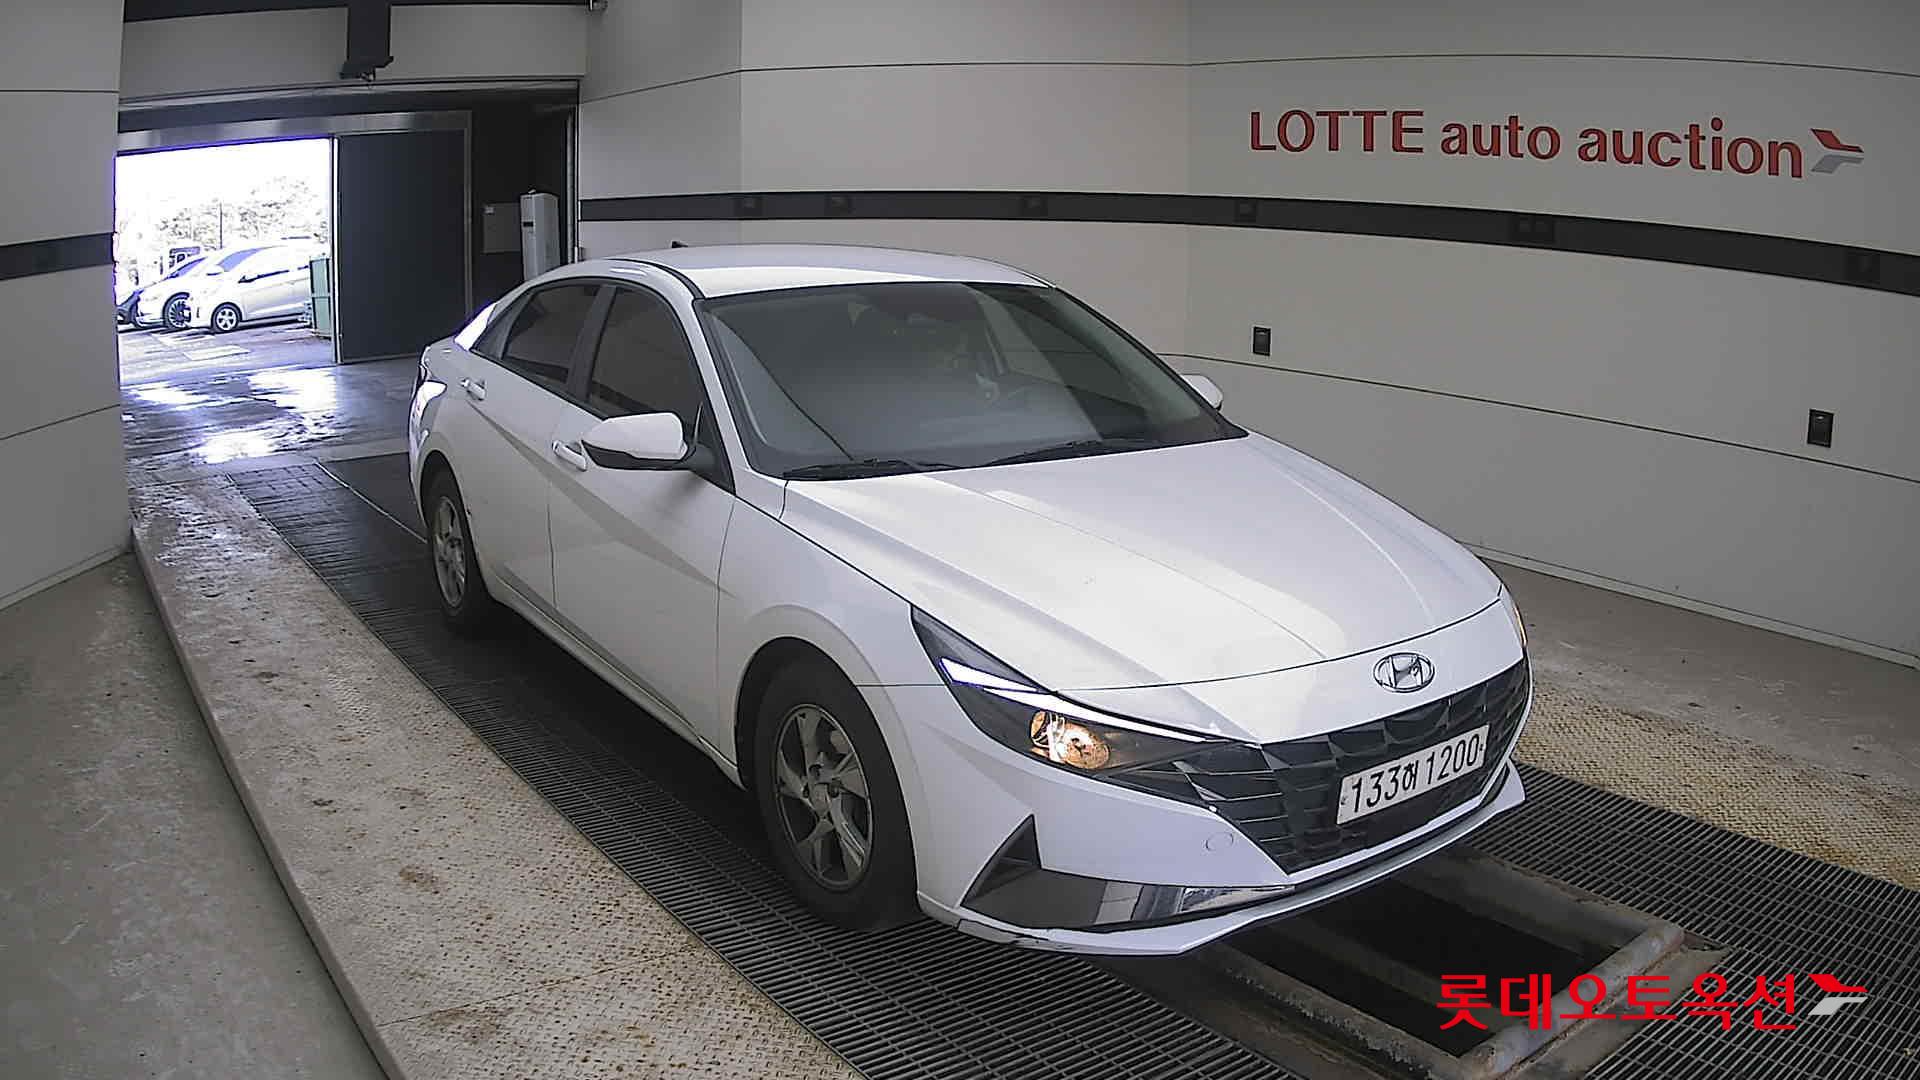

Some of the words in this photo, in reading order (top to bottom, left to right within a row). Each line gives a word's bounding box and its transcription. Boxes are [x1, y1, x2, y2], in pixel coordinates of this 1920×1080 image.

[1250, 110, 1425, 153] LOTTE
[1440, 114, 1562, 160] auto
[1577, 117, 1803, 178] auction
[1351, 759, 1419, 813] 133허
[1426, 733, 1481, 785] 1200
